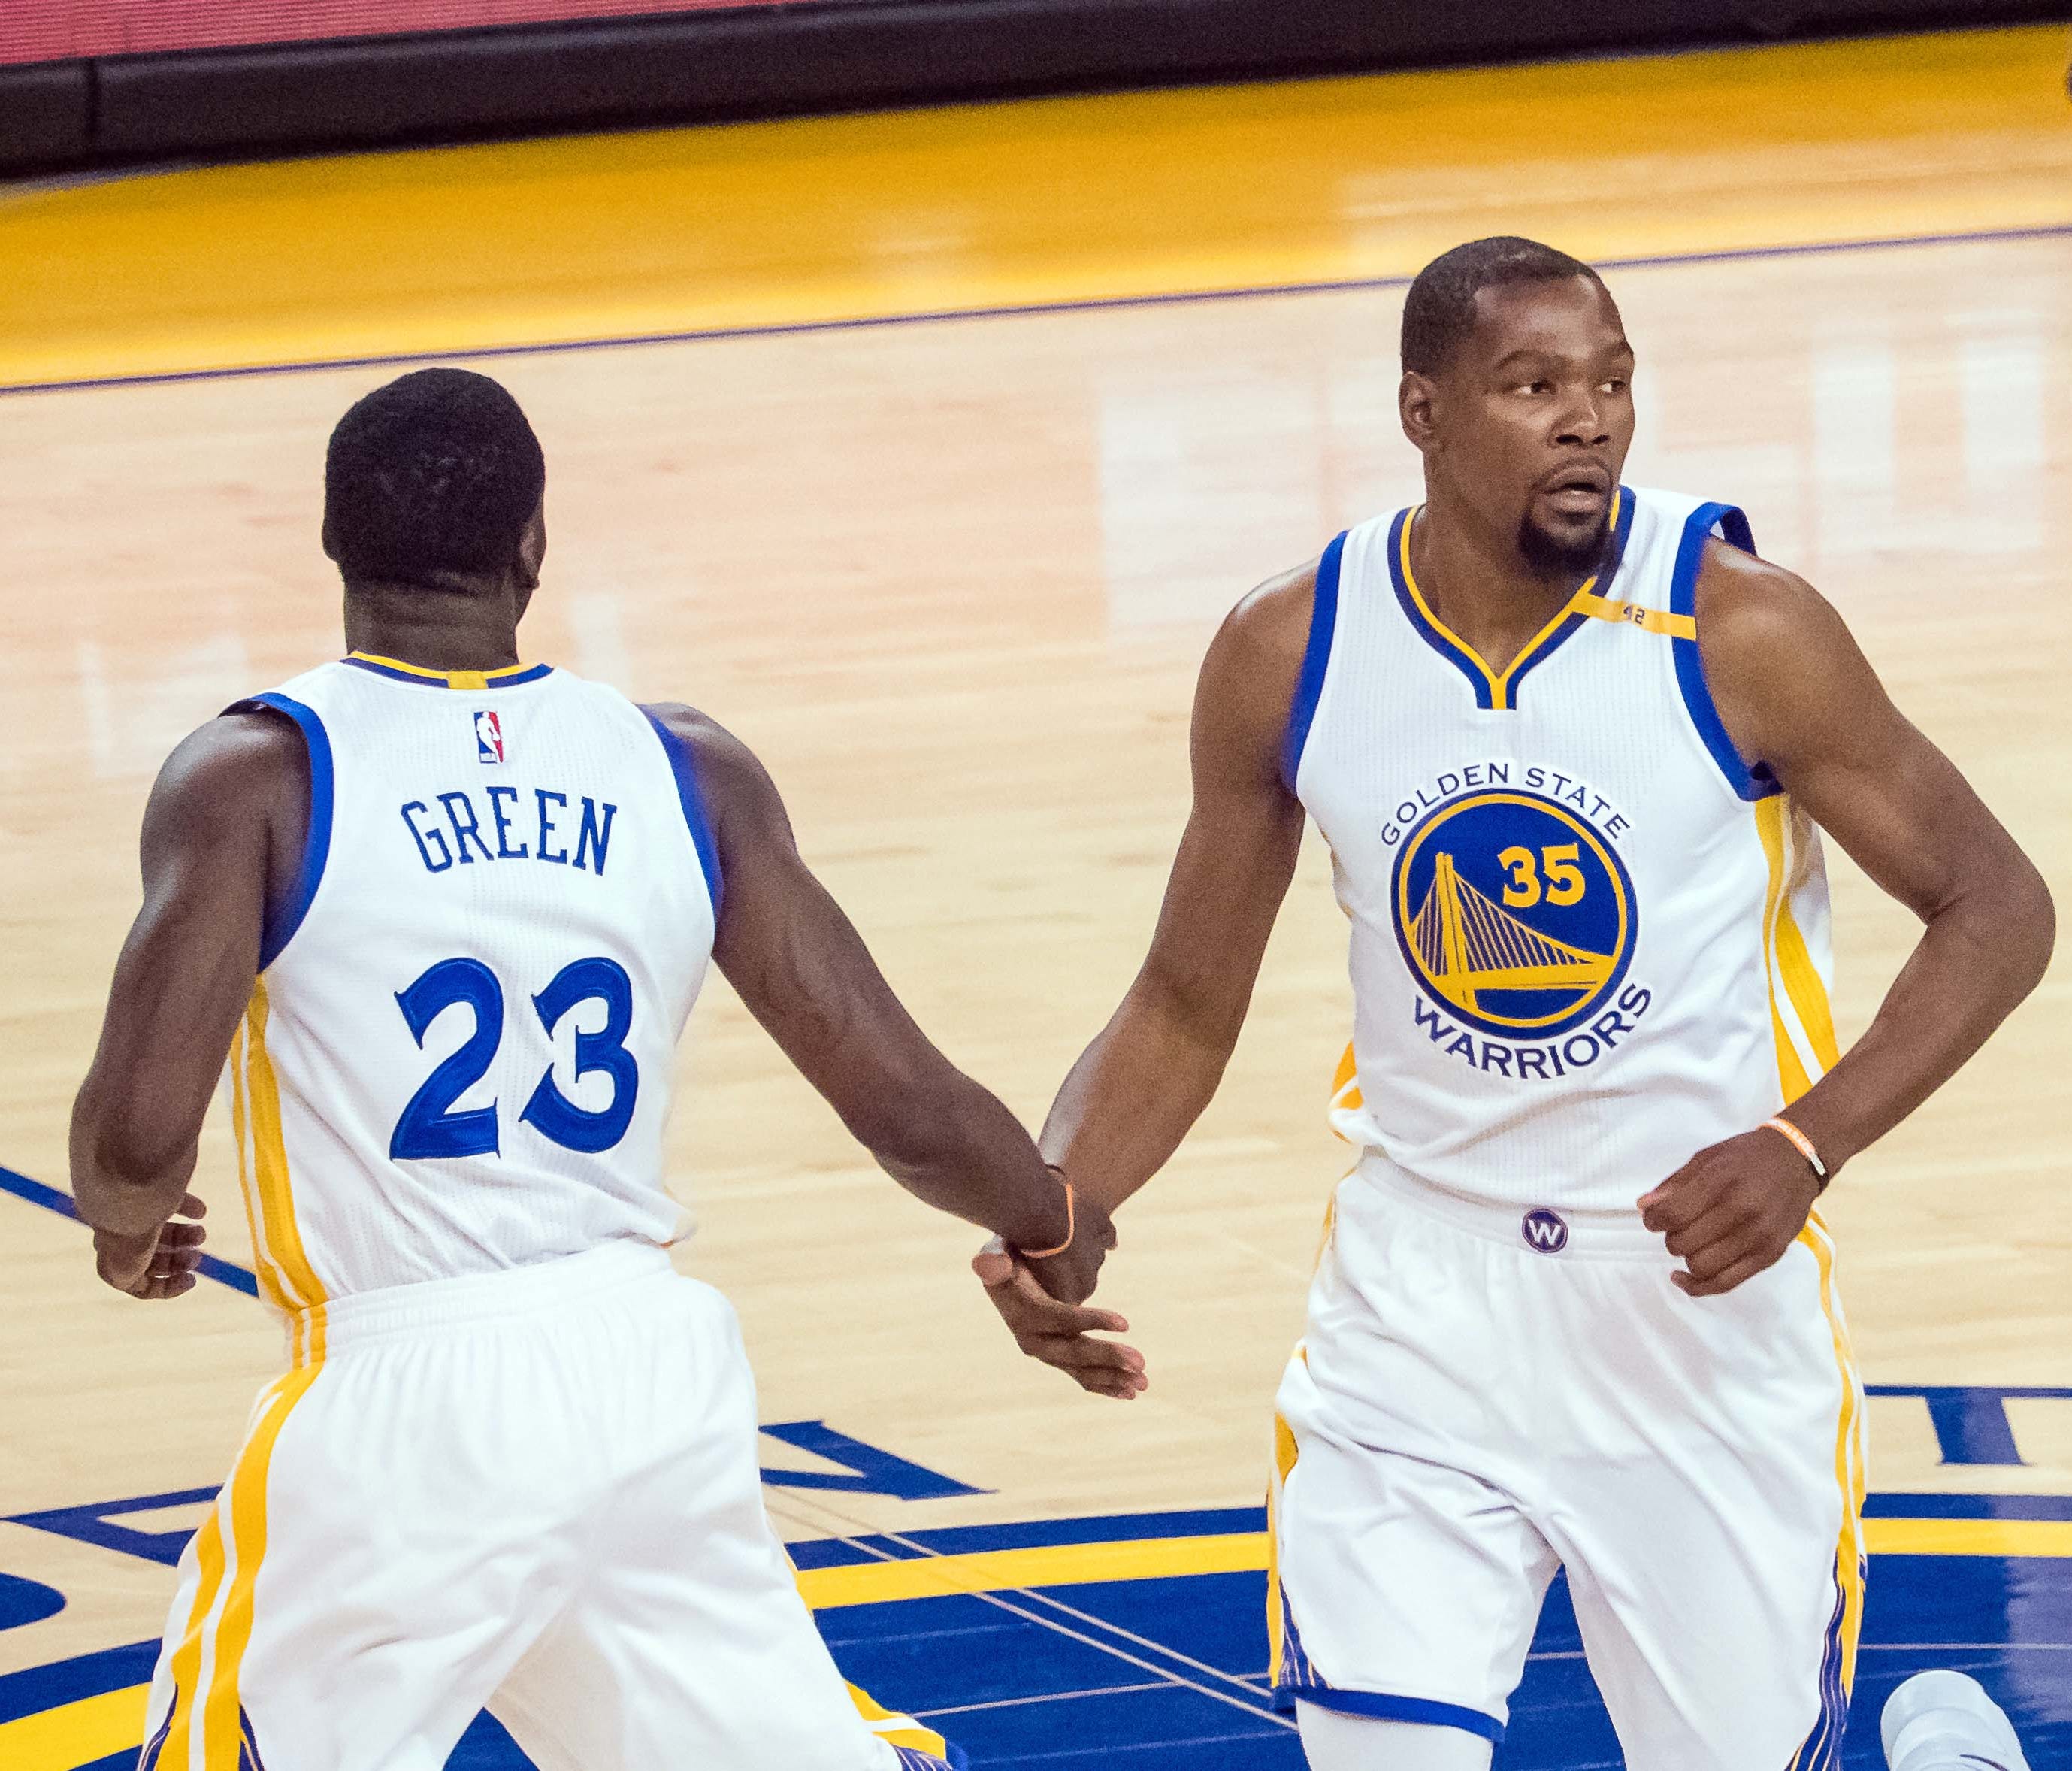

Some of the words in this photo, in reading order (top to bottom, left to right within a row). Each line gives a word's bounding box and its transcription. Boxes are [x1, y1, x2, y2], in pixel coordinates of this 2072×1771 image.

[1623, 606, 1644, 624] 42
[401, 786, 617, 876] GREEN
[1381, 763, 1509, 846] GOLDEN
[1526, 767, 1631, 840] STATE
[1498, 843, 1586, 908] 35
[389, 957, 639, 1161] 23
[1414, 983, 1651, 1079] WARRIORS
[1529, 1219, 1560, 1246] W
